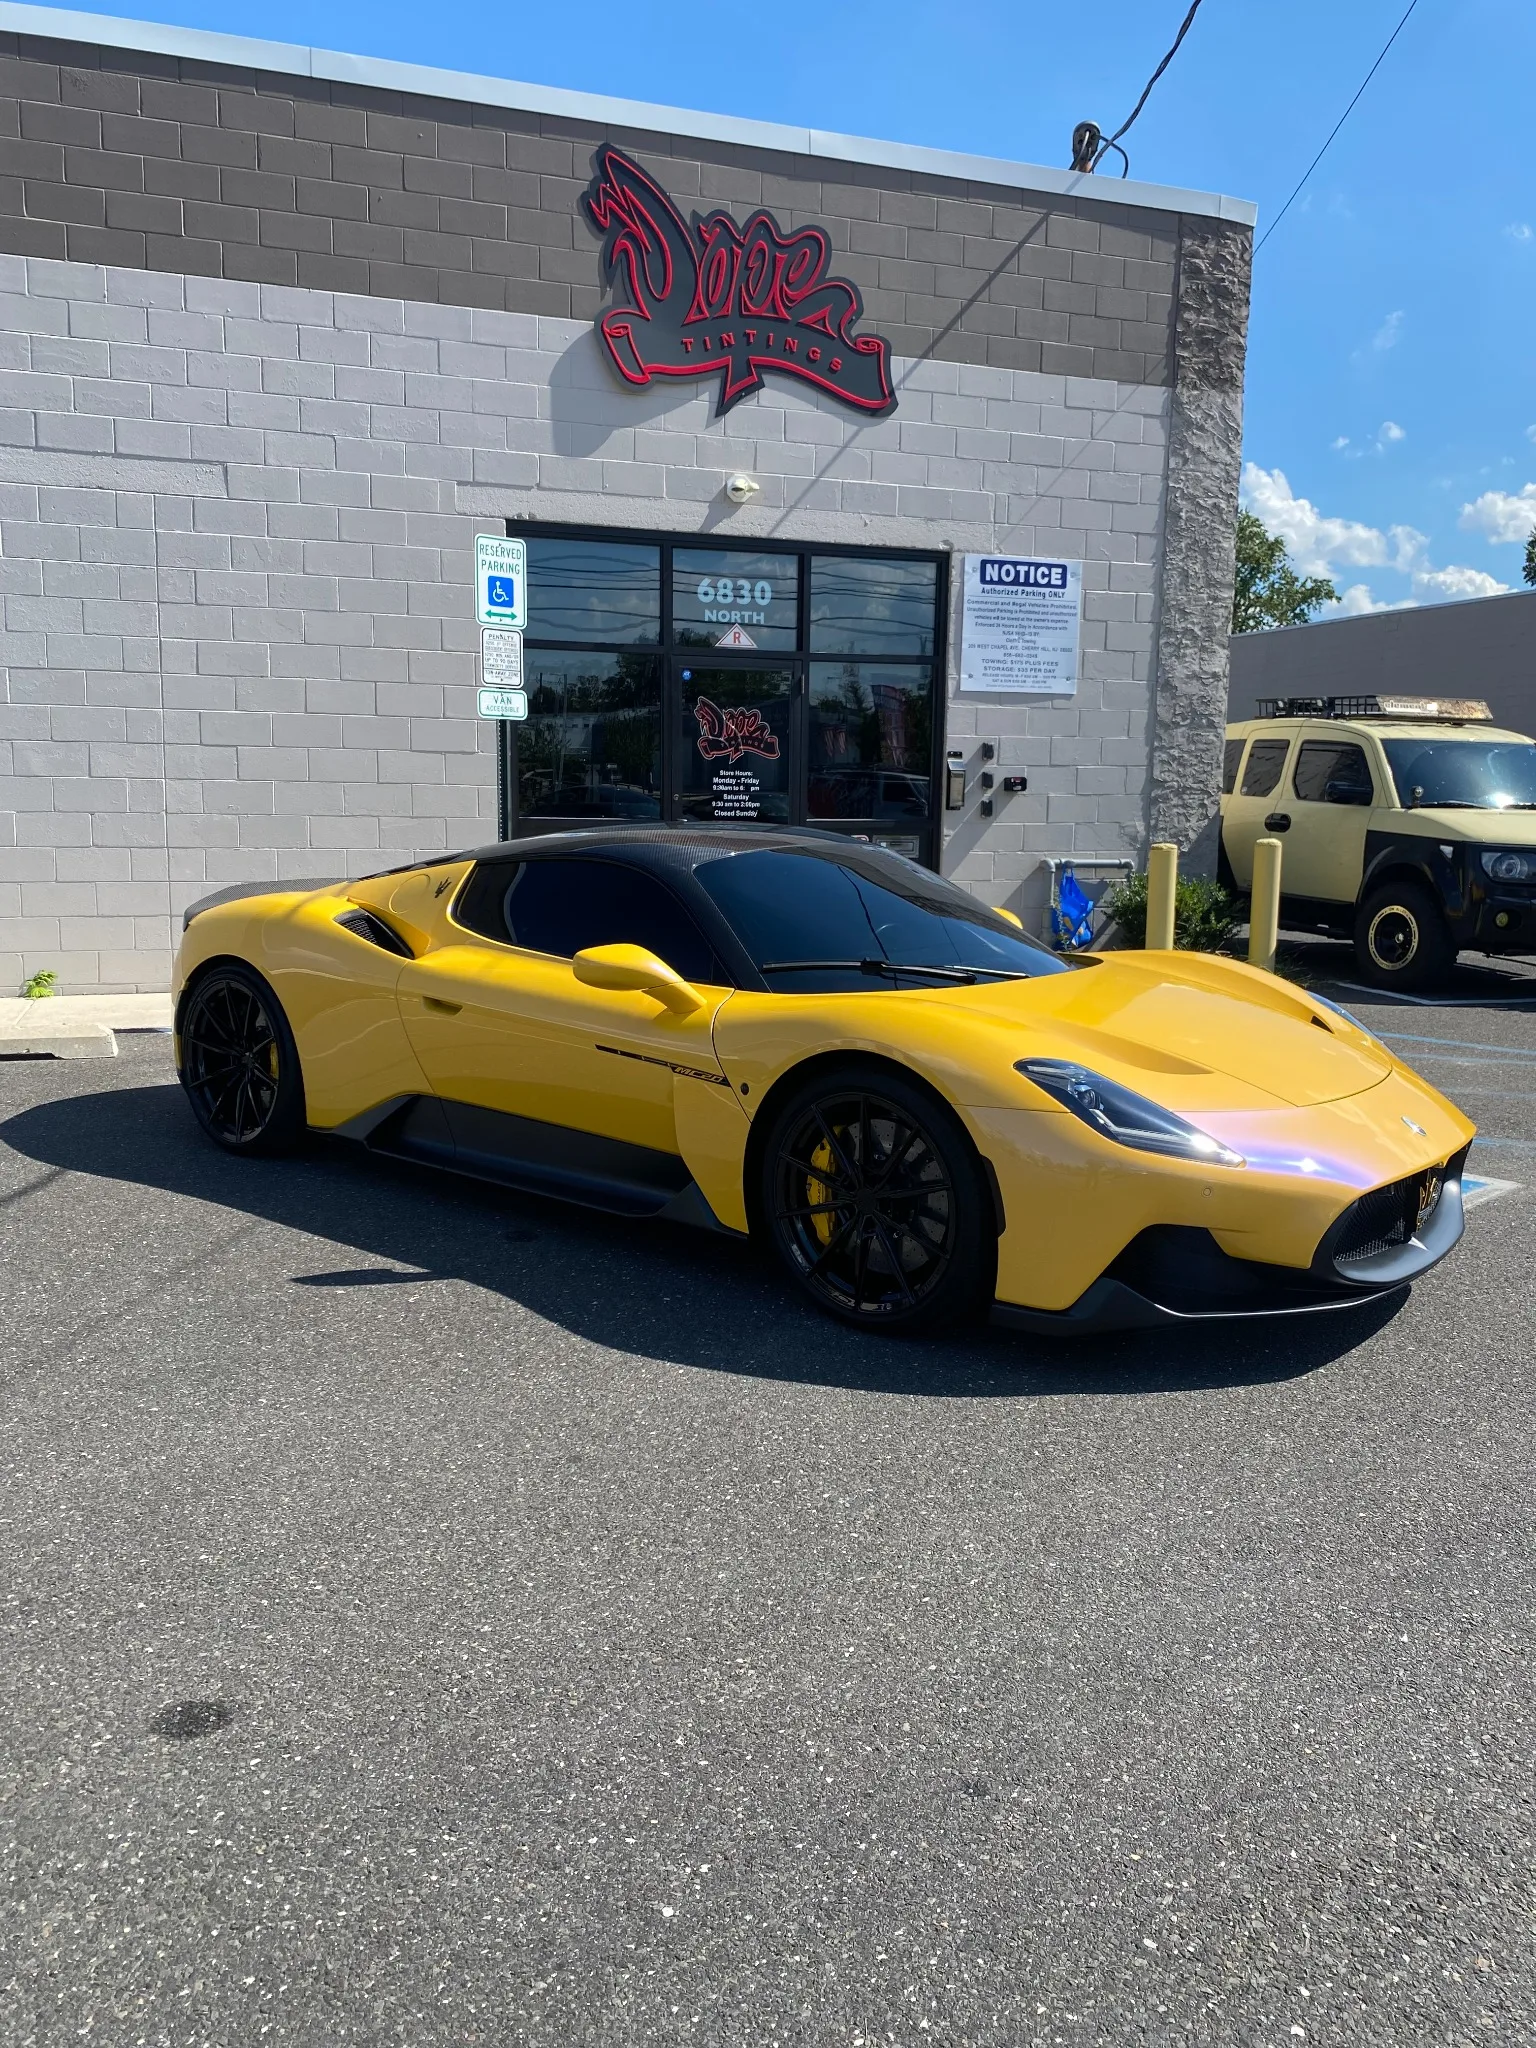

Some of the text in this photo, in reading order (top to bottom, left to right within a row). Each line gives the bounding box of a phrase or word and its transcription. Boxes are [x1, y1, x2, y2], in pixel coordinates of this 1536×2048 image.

[681, 329, 842, 371] TINTINGS
[480, 544, 521, 559] RESERVED
[482, 560, 520, 574] PARKING
[985, 564, 1062, 585] NOTICE
[697, 578, 771, 606] 6830
[981, 587, 1065, 600] Authorized Parking ONLY
[705, 609, 765, 624] NORTH
[733, 631, 742, 644] R
[493, 695, 512, 704] VAN
[486, 705, 519, 713] ACCESSIBLE
[674, 1067, 723, 1083] MC20
